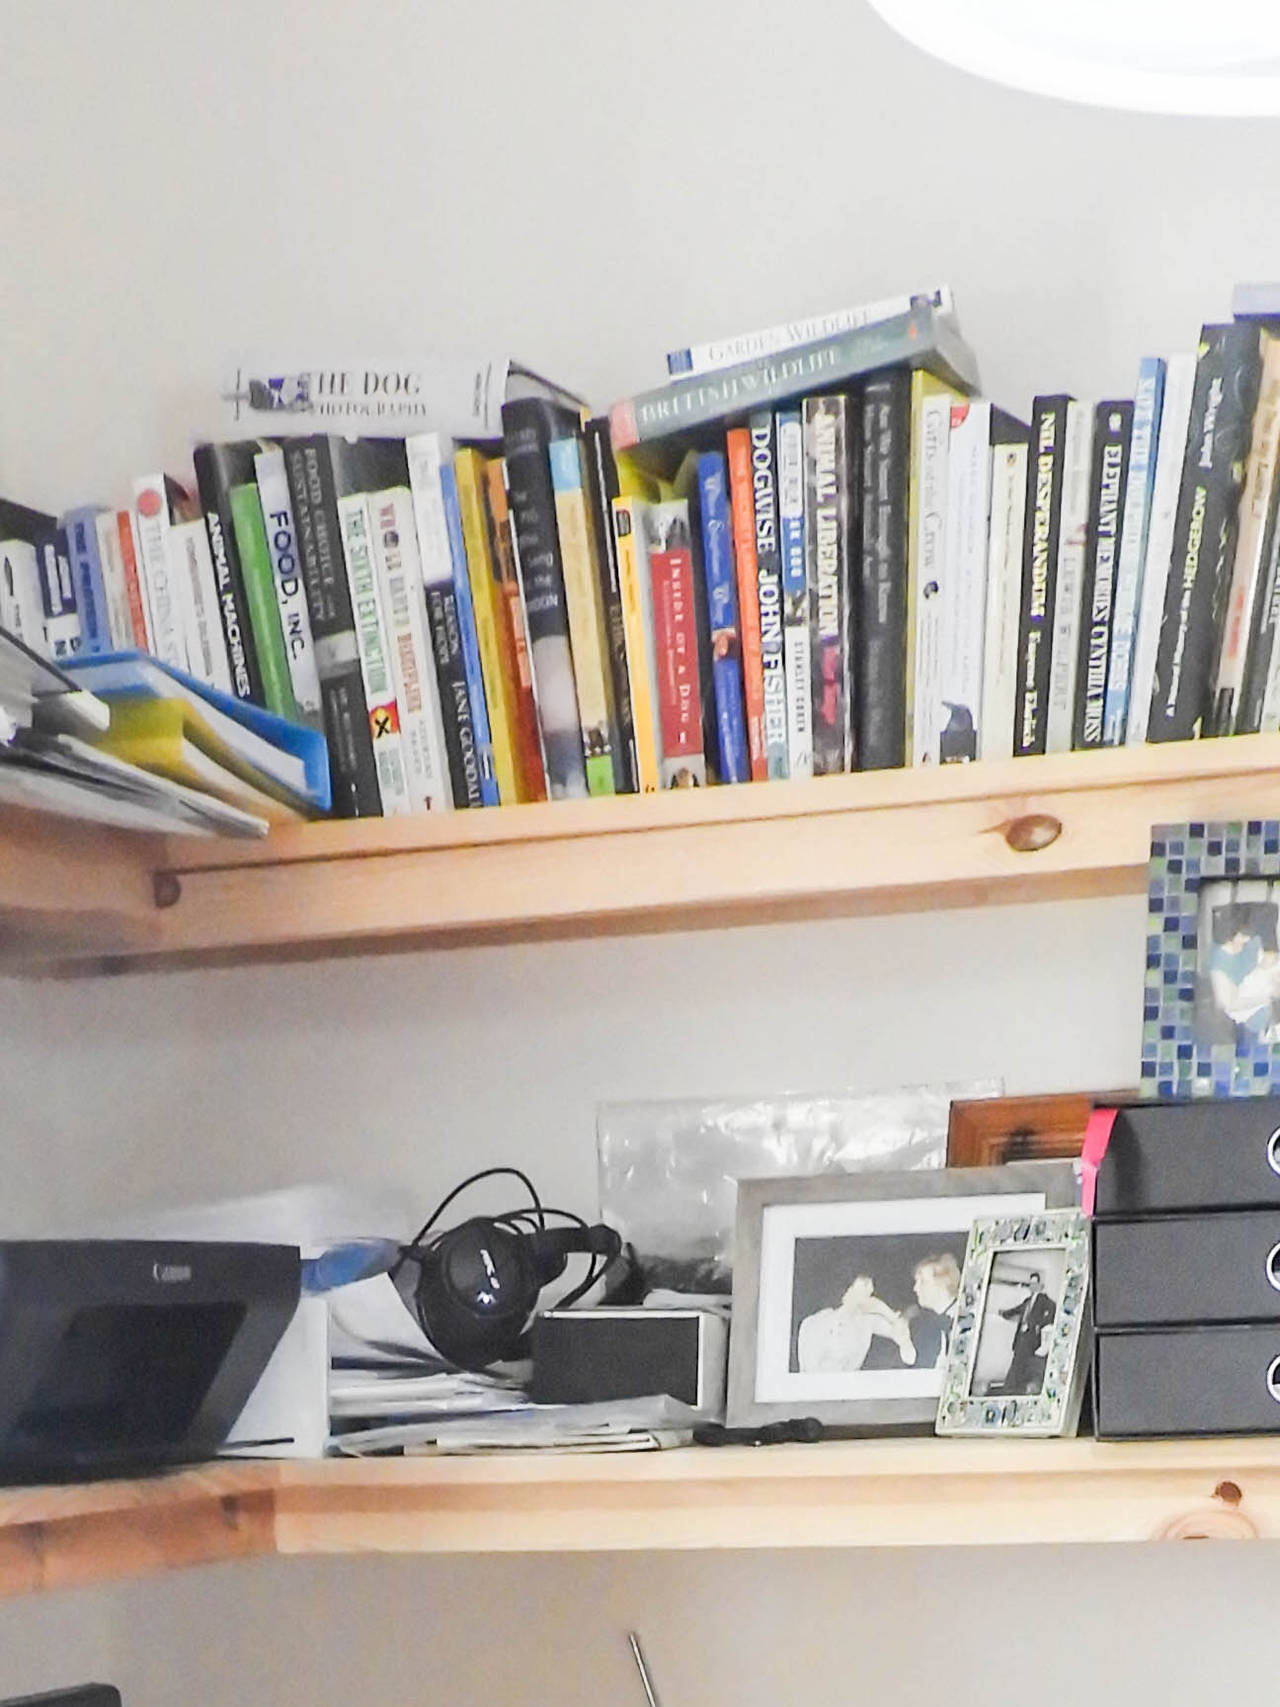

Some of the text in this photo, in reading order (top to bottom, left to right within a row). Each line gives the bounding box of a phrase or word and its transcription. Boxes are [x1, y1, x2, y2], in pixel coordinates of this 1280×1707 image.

[814, 413, 837, 502] ANIMAL
[1037, 410, 1056, 454] NIL
[749, 425, 777, 553] DOGWISE
[267, 510, 301, 605] FOOD,
[816, 508, 838, 638] LIBERATION
[757, 568, 781, 644] JOHN
[762, 652, 787, 745] FISHER
